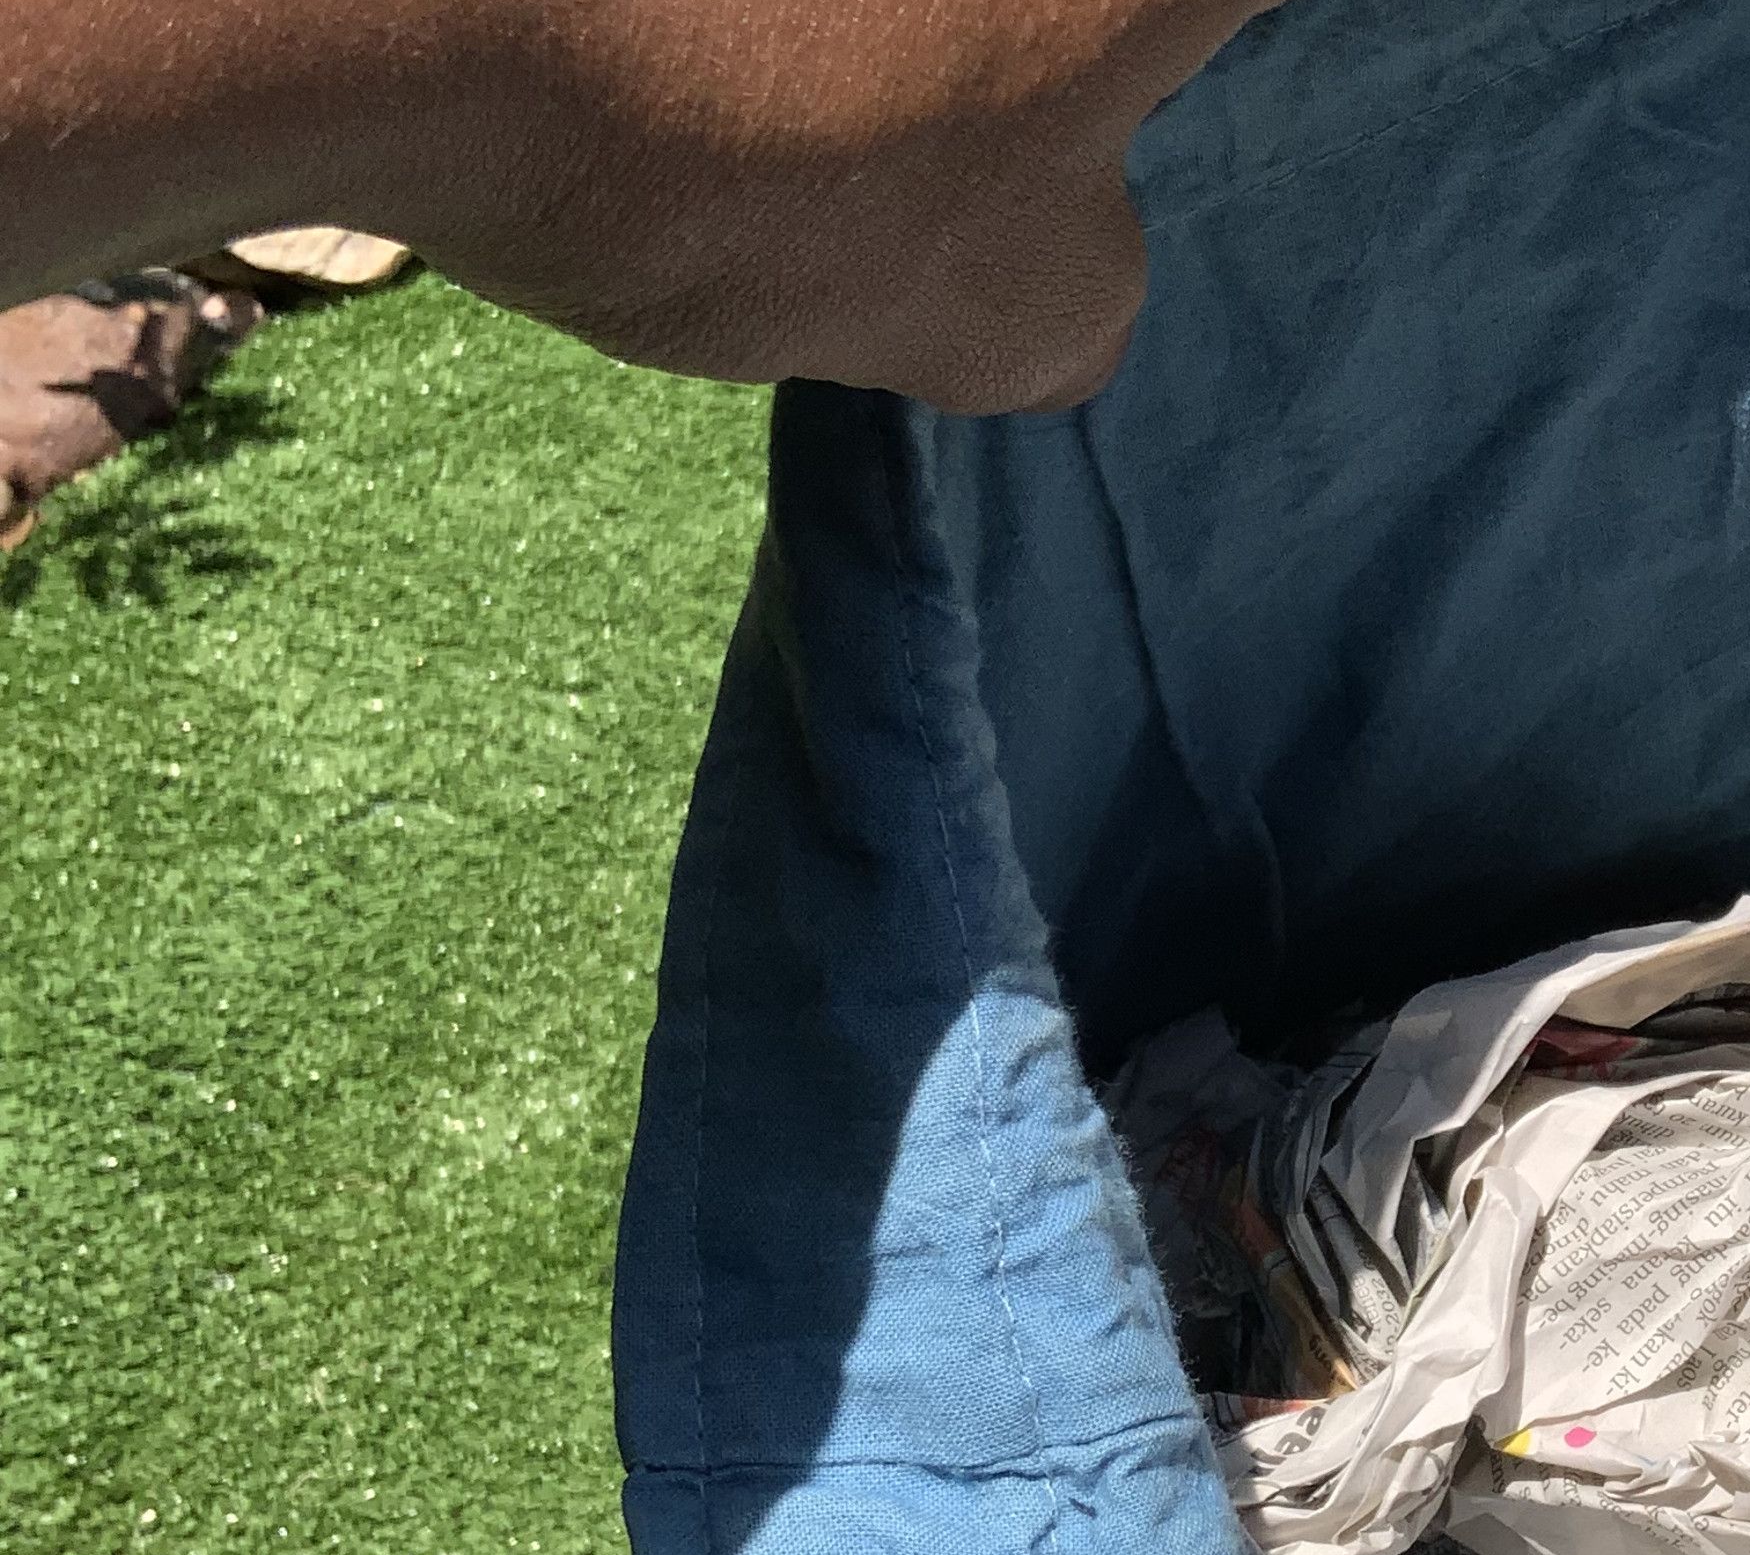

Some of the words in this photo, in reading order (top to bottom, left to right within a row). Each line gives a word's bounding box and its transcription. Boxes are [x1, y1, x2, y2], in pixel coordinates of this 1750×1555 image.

[1699, 1191, 1740, 1232] itu
[1554, 1297, 1615, 1353] seka-
[1614, 1281, 1669, 1339] pada
[1575, 1337, 1617, 1378] ke-
